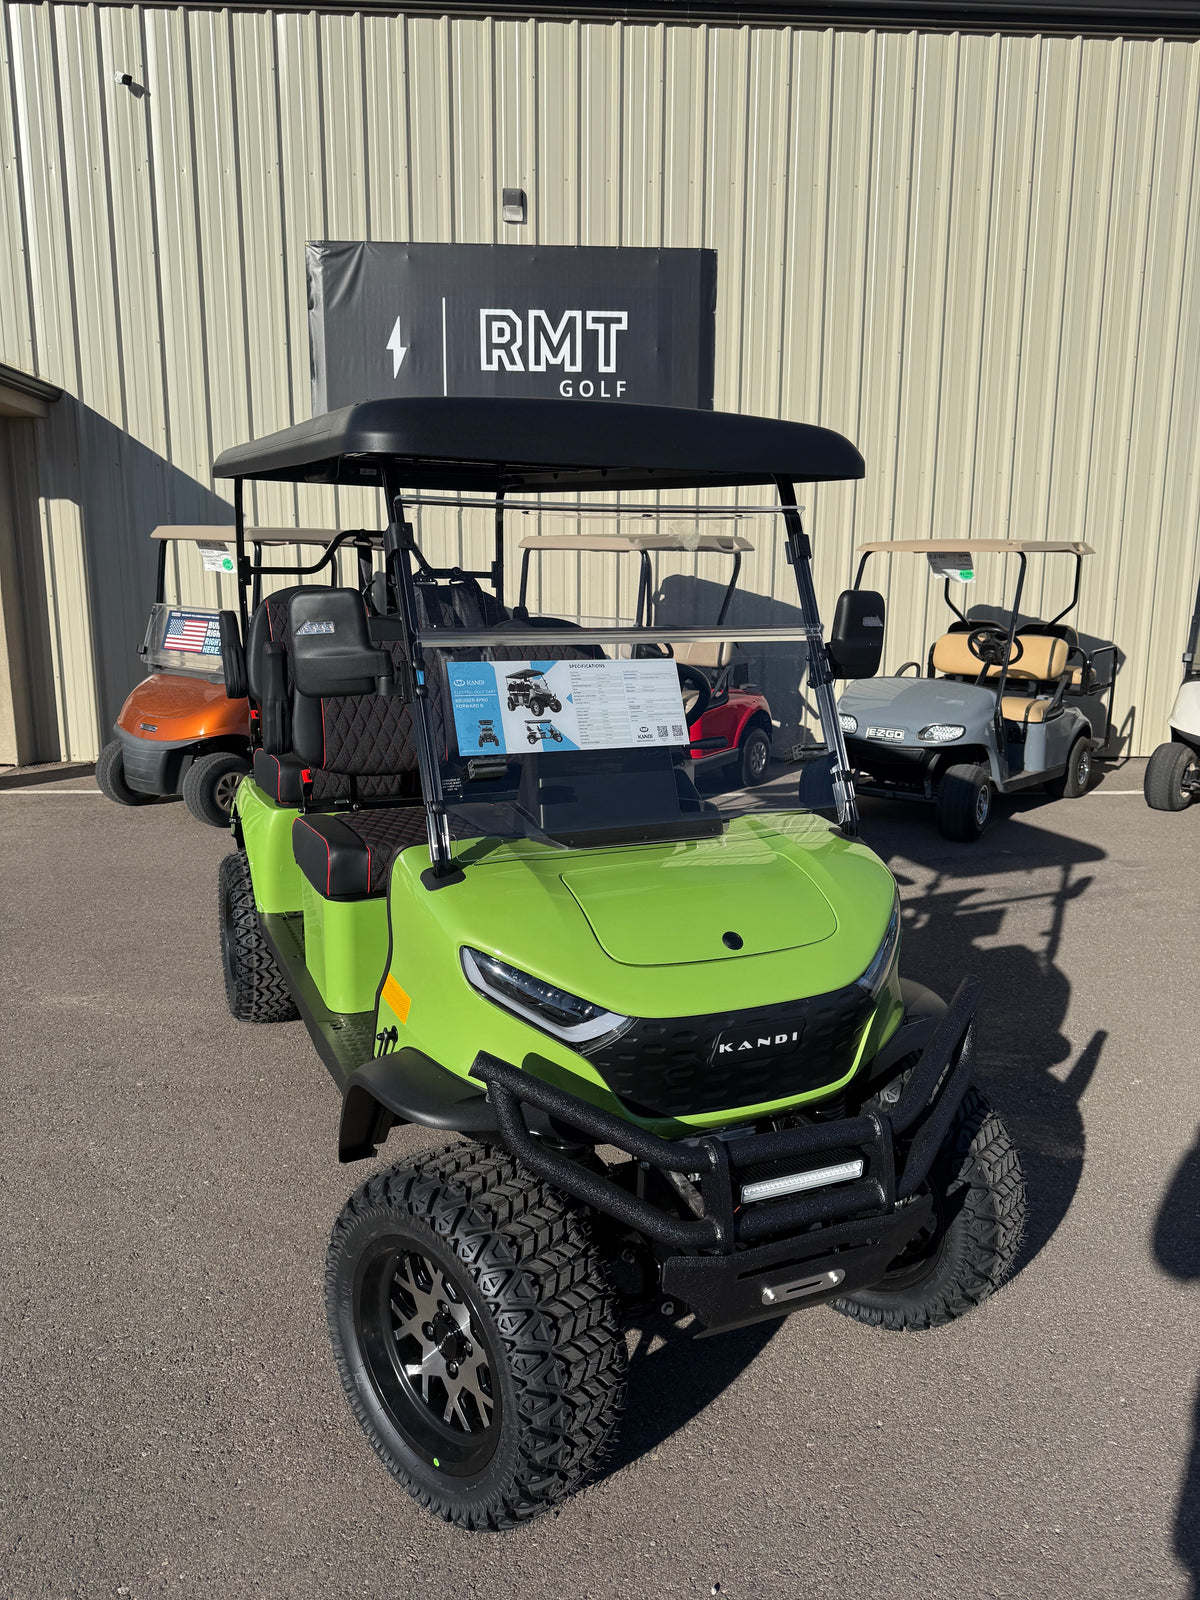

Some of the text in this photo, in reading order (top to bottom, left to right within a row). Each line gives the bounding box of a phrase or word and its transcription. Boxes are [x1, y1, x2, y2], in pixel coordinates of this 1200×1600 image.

[480, 309, 628, 372] RMT
[559, 380, 627, 398] GOLF
[206, 629, 221, 638] RIGH
[719, 1031, 798, 1054] KANDI
